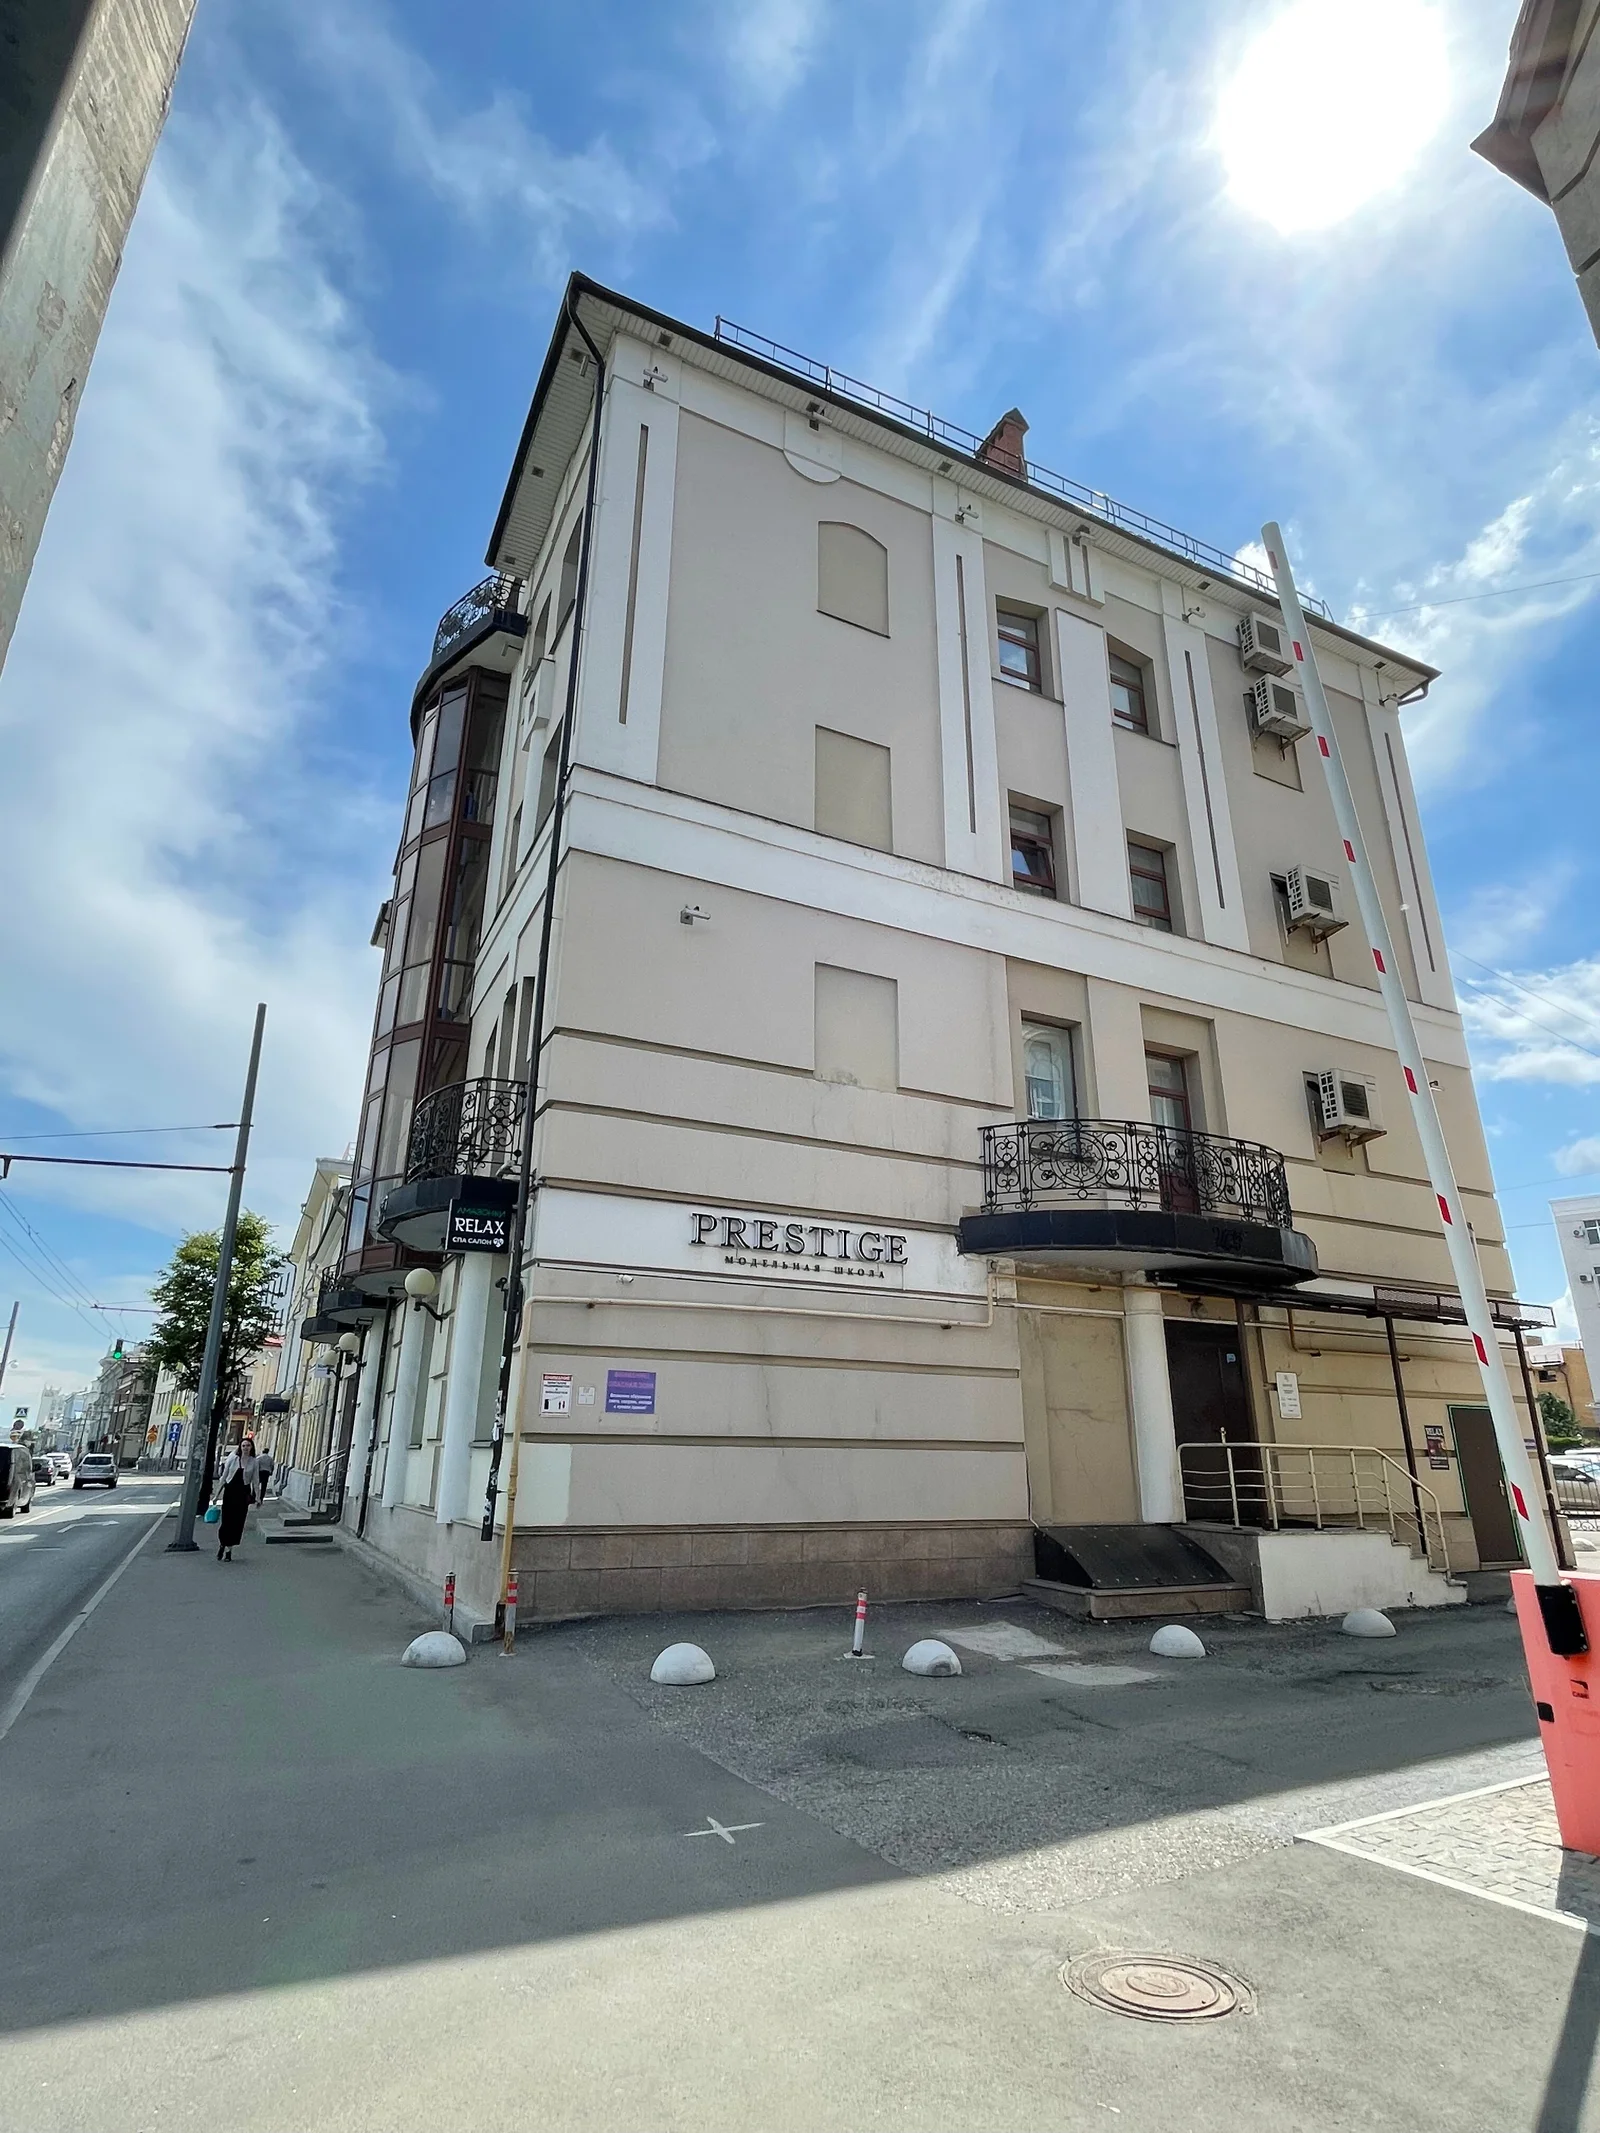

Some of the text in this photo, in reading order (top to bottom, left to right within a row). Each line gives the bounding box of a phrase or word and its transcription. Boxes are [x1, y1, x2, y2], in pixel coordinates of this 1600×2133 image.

[455, 1217, 505, 1235] RELAX
[452, 1236, 492, 1246] СПА САЛОН
[691, 1213, 908, 1265] PRESTIGE
[724, 1255, 885, 1279] МОДЕЛЬНАЯ ШКОЛА
